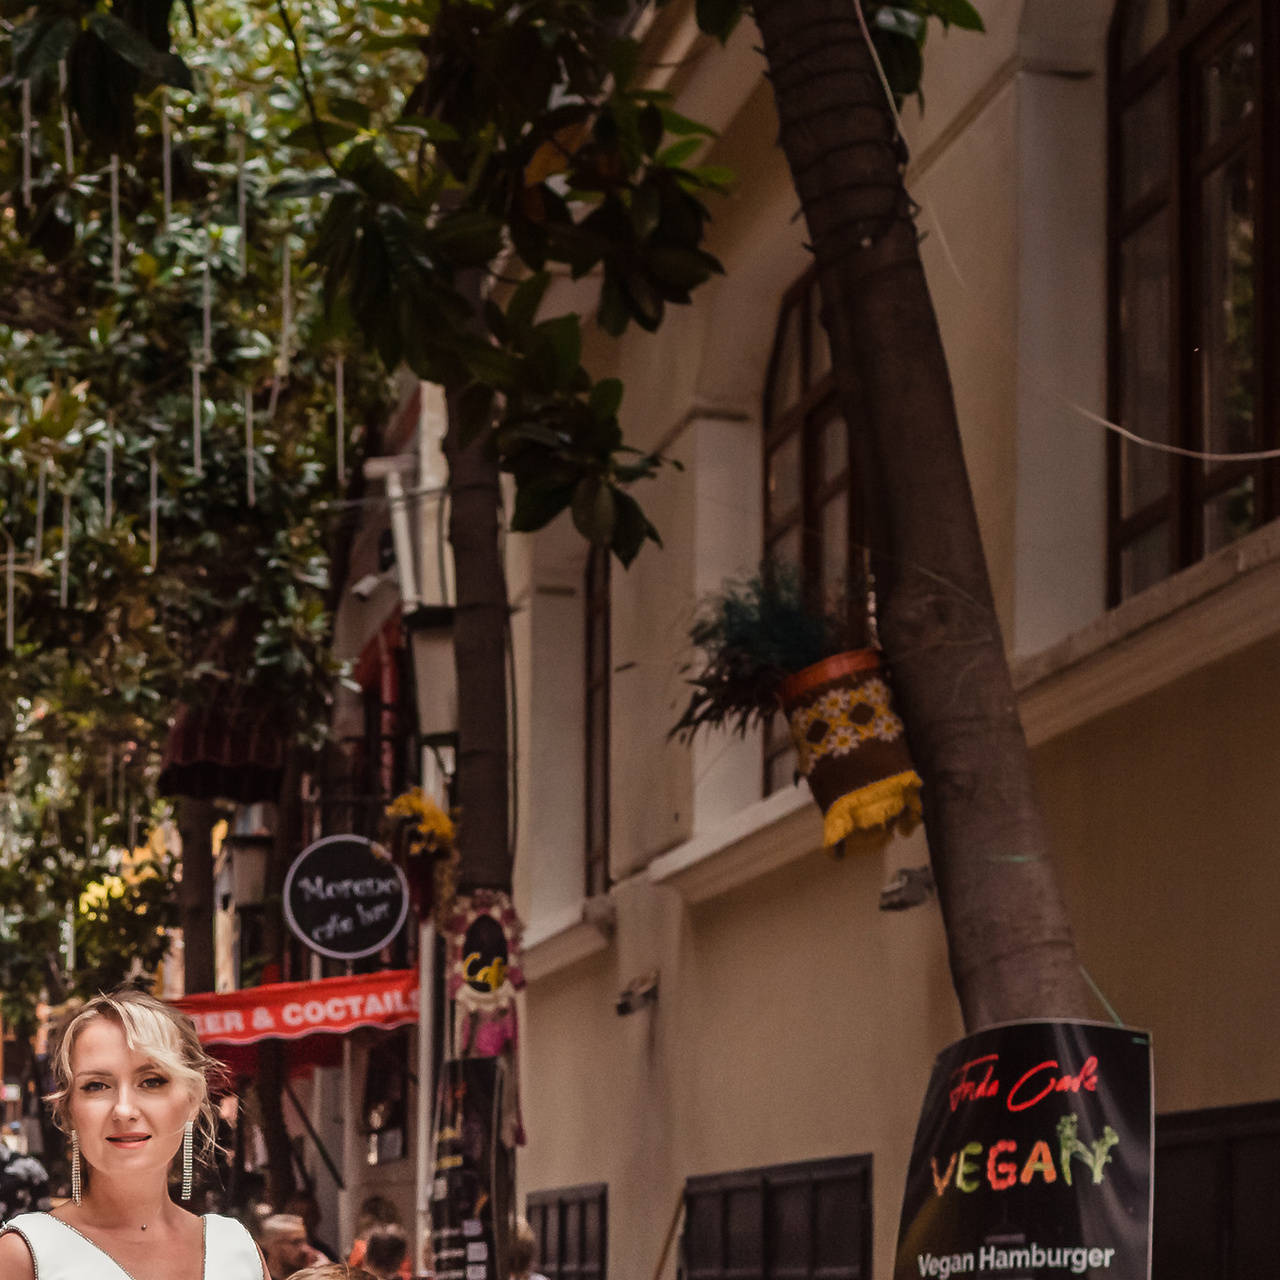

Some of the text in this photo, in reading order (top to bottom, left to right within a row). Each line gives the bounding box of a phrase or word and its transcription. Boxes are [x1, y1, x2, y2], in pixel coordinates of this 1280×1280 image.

[252, 1007, 275, 1030] &
[930, 1112, 1119, 1197] VEGAN
[918, 1242, 1115, 1280] Vegan Hamburger
